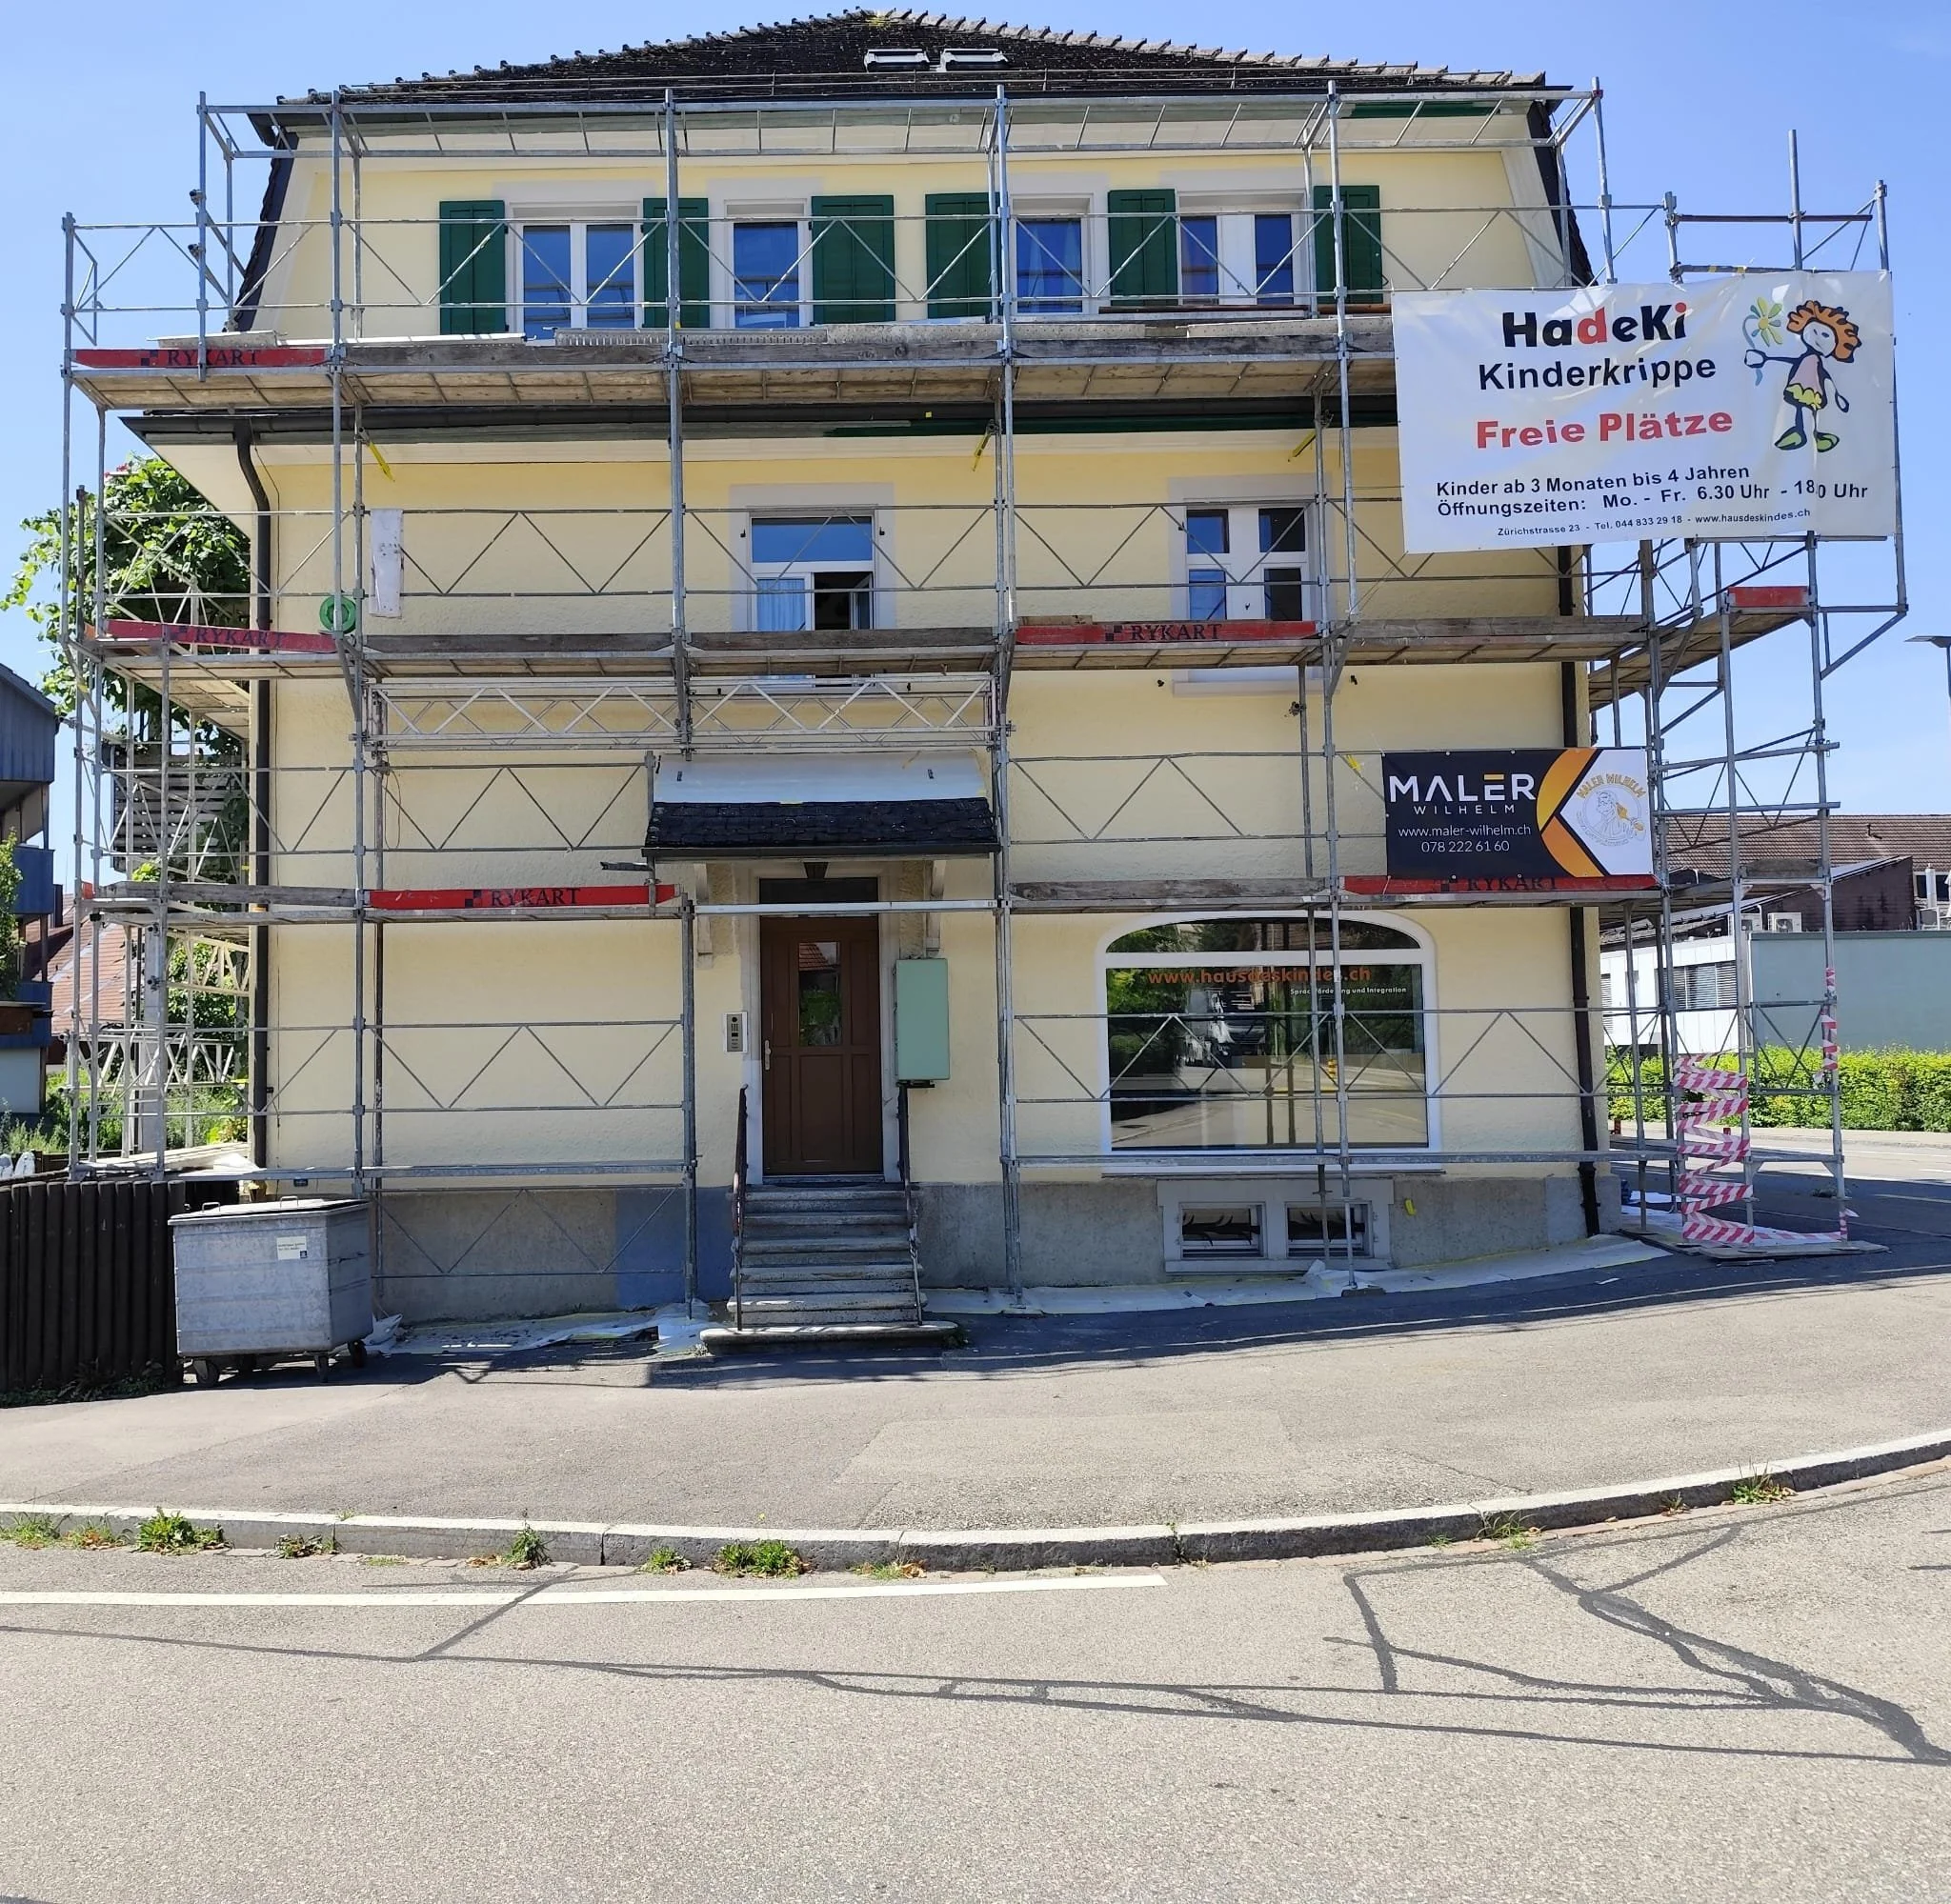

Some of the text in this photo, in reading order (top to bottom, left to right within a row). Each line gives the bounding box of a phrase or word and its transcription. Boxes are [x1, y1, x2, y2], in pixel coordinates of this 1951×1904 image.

[1502, 302, 1687, 347] HadeKi
[1478, 357, 1716, 390] Kinderkrippe
[1477, 411, 1733, 449] Freie Plätze
[1437, 466, 1749, 496] Kinder ab 3 Monaten bis 4 Jahren
[1438, 499, 1585, 517] Öffnungszeiten:
[1603, 493, 1638, 509] Mo.
[1660, 489, 1686, 503] Fr.
[1698, 485, 1735, 500] 6.30
[1740, 484, 1770, 499] Uhr
[1834, 483, 1868, 498] Uhr
[1498, 526, 1565, 536] Zürichstrasse
[1568, 524, 1580, 532] 23
[1596, 521, 1613, 530] Tel.
[1615, 519, 1633, 528] 044
[1636, 517, 1654, 526] 833
[1656, 516, 1668, 525] 29
[1695, 509, 1810, 523] www.hausdeskindes.ch
[195, 626, 287, 648] RYKART
[1131, 623, 1221, 641] RYKART
[1389, 773, 1537, 803] MALER
[1576, 774, 1604, 799] MALER
[1414, 804, 1515, 815] WILHELM
[1398, 824, 1531, 837] www.maler-wilhelm.ch
[1421, 840, 1510, 853] 078 222 61 60
[492, 888, 581, 907] RYKART
[1366, 986, 1407, 994] Integration
